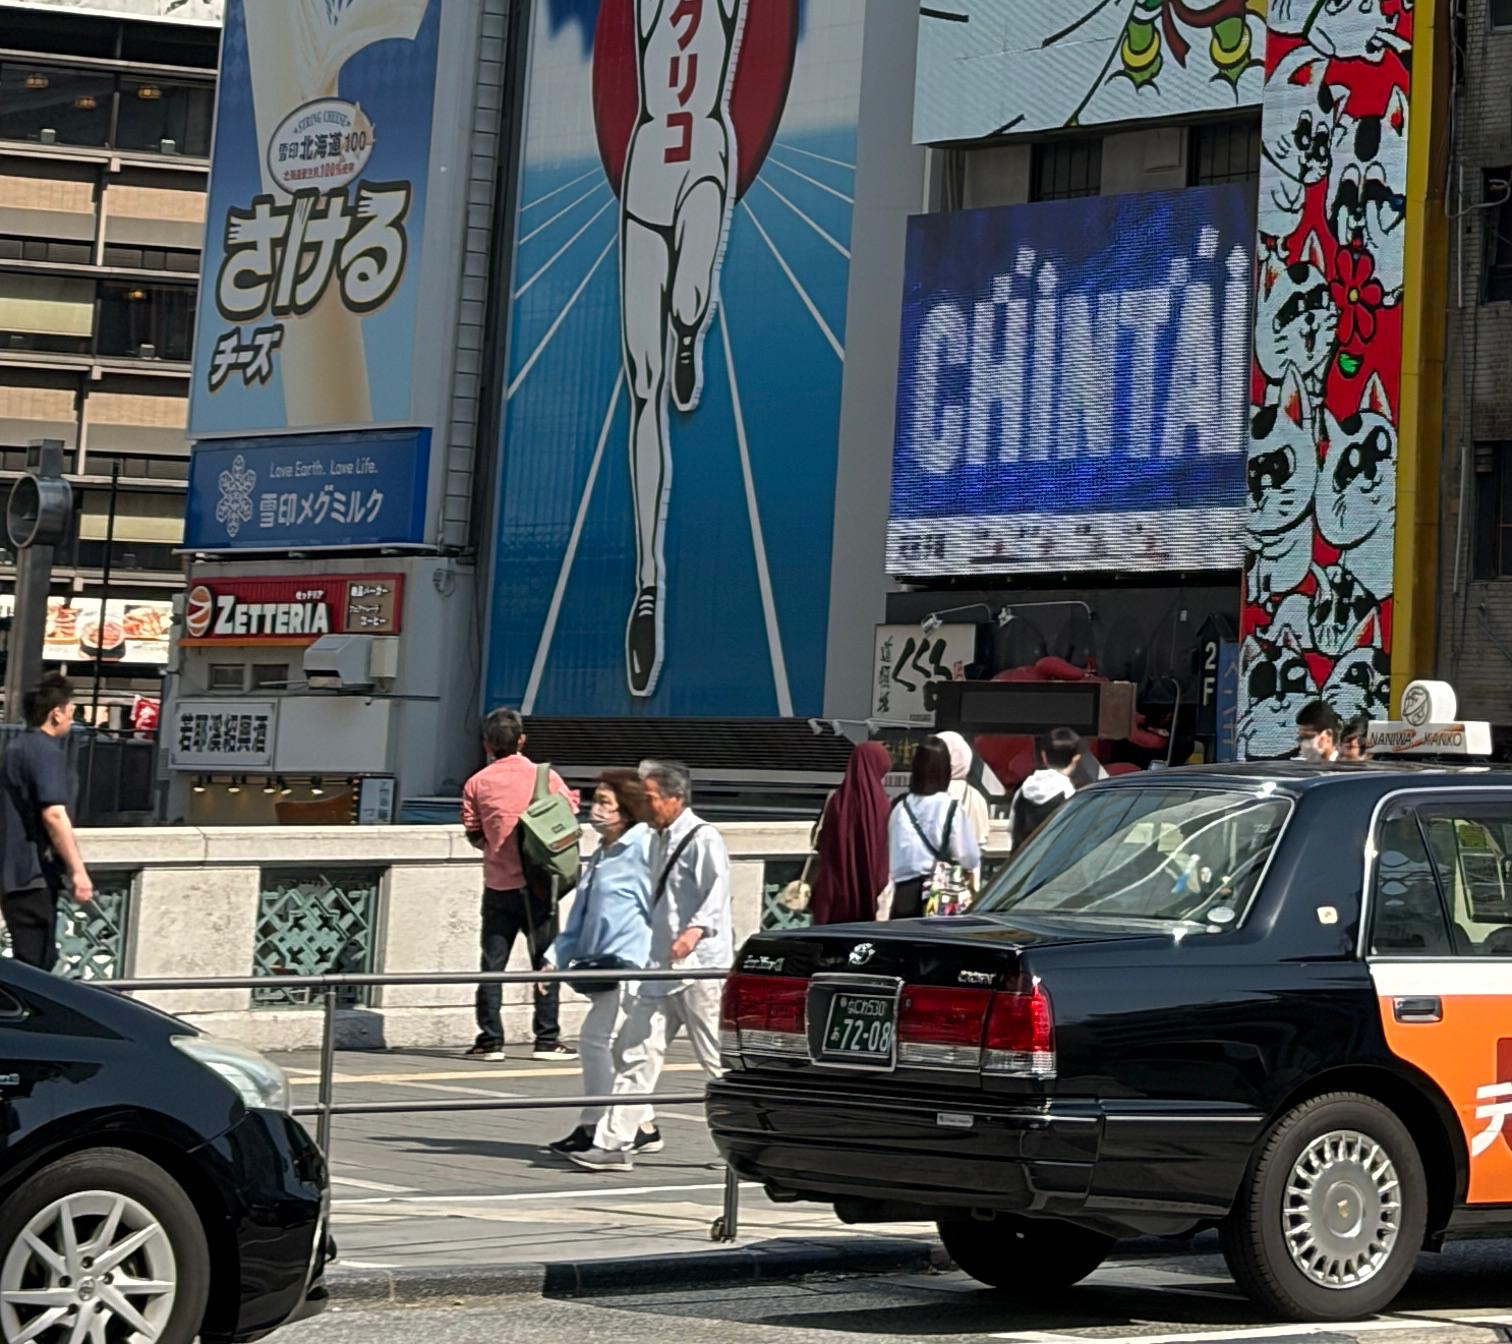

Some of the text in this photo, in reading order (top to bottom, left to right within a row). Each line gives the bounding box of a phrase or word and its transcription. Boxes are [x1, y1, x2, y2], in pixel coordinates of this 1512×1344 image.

[217, 180, 411, 320] さける
[209, 323, 283, 392] チーズ
[912, 224, 1248, 474] CHINTAI
[270, 462, 293, 478] Love
[330, 459, 354, 475] Love
[259, 484, 384, 528] 雪印メグミルク
[214, 595, 329, 635] ZETTERIA
[1203, 641, 1217, 706] 2F
[1424, 733, 1462, 746] KANKO
